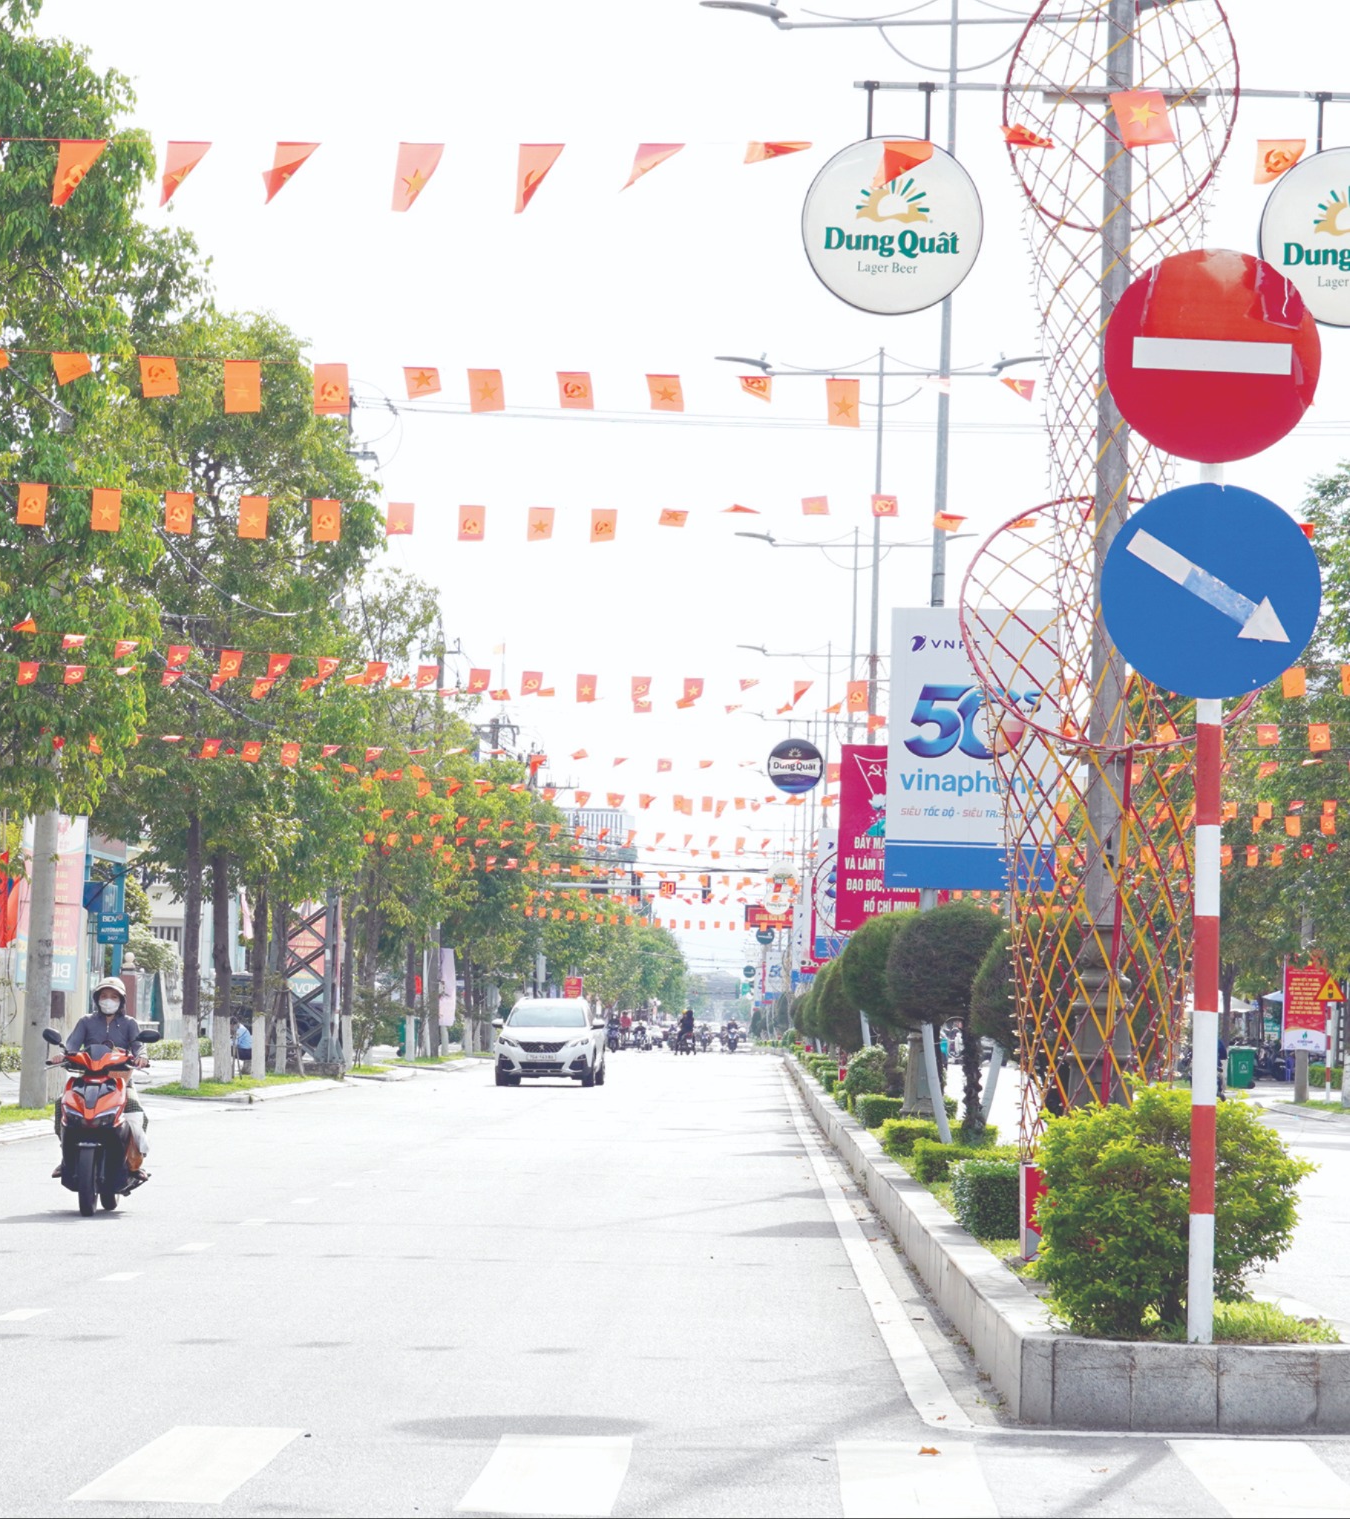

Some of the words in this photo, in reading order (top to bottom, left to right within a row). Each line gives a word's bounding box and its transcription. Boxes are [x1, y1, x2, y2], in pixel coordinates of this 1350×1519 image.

[824, 226, 895, 257] Dung
[897, 229, 960, 258] Quất
[1283, 242, 1350, 272] Dung
[857, 261, 888, 276] Lager
[891, 262, 918, 274] Beer
[1317, 276, 1350, 290] Lager
[931, 639, 980, 650] VNP
[773, 762, 795, 772] Dung
[900, 768, 1044, 797] vinaphone
[901, 806, 921, 817] SIÊU
[923, 804, 940, 817] TỐC
[962, 808, 983, 819] SIÊU
[844, 855, 856, 871] VÀ
[857, 856, 876, 871] LÀM
[846, 878, 864, 894] ĐẠO
[865, 877, 885, 894] ĐỨC,
[863, 896, 875, 913] HỒ
[877, 898, 892, 913] CHÍ
[893, 900, 917, 912] MINH
[102, 915, 117, 923] BIDV
